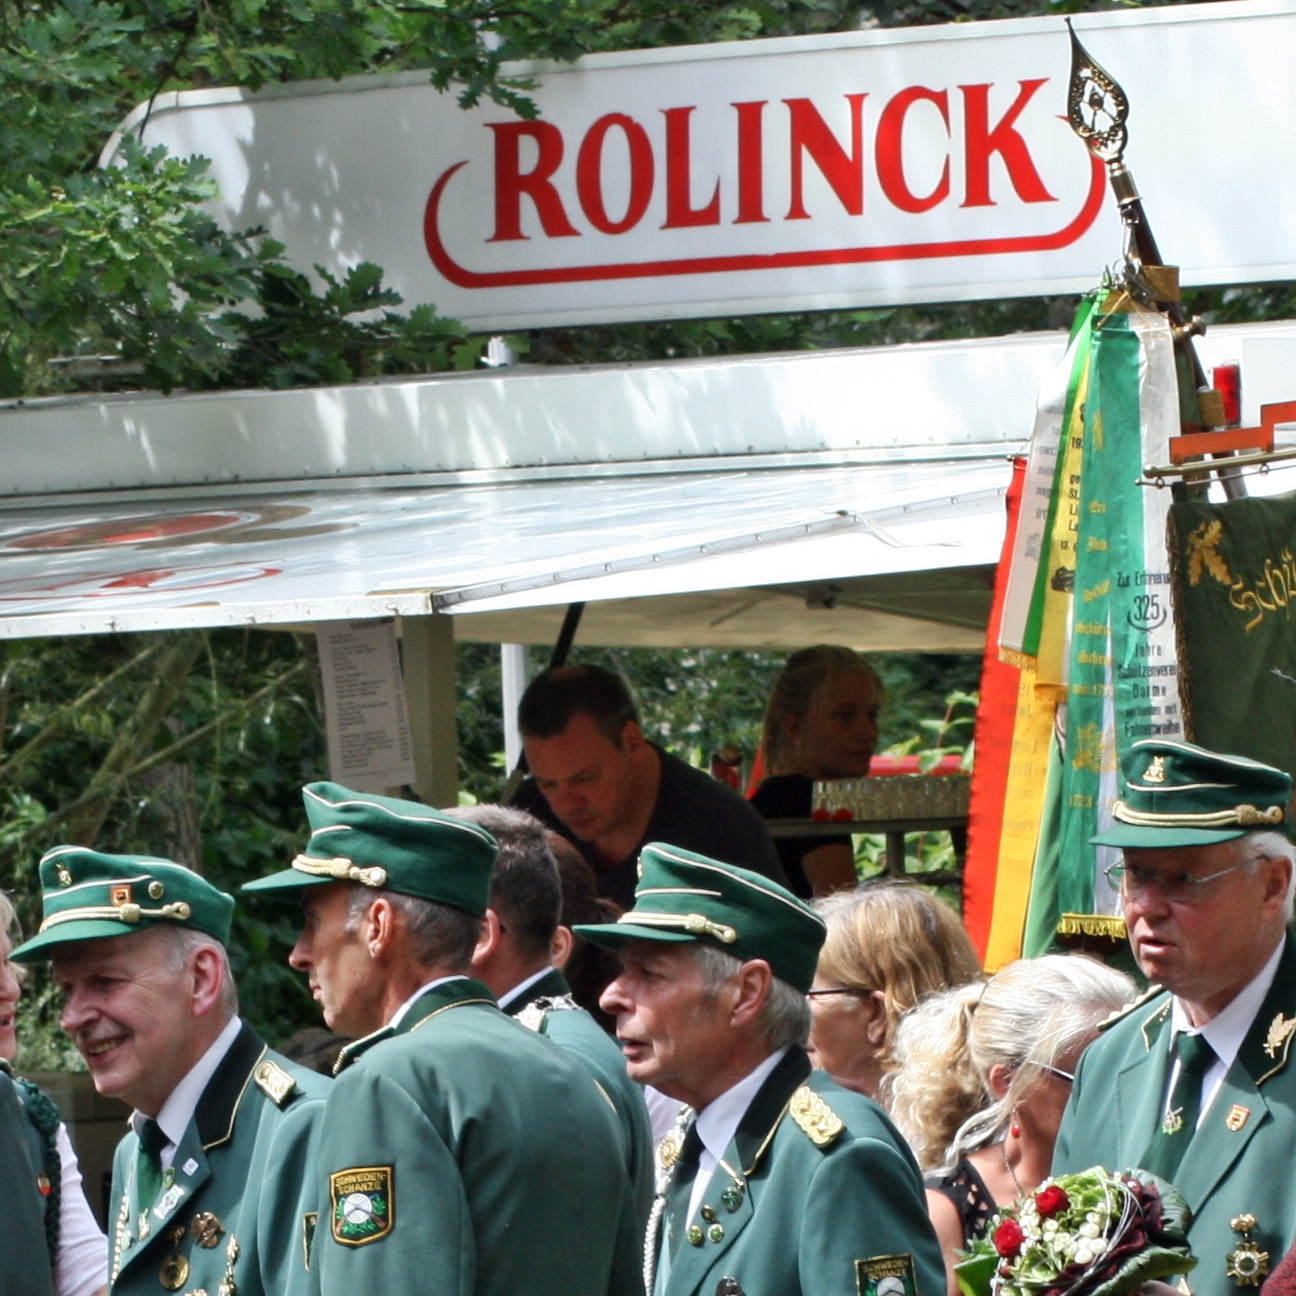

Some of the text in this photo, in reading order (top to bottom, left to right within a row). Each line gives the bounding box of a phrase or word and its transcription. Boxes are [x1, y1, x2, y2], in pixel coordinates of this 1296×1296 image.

[483, 77, 1061, 243] ROLINCK
[1133, 594, 1160, 621] 325
[338, 1182, 382, 1195] SCHANZE
